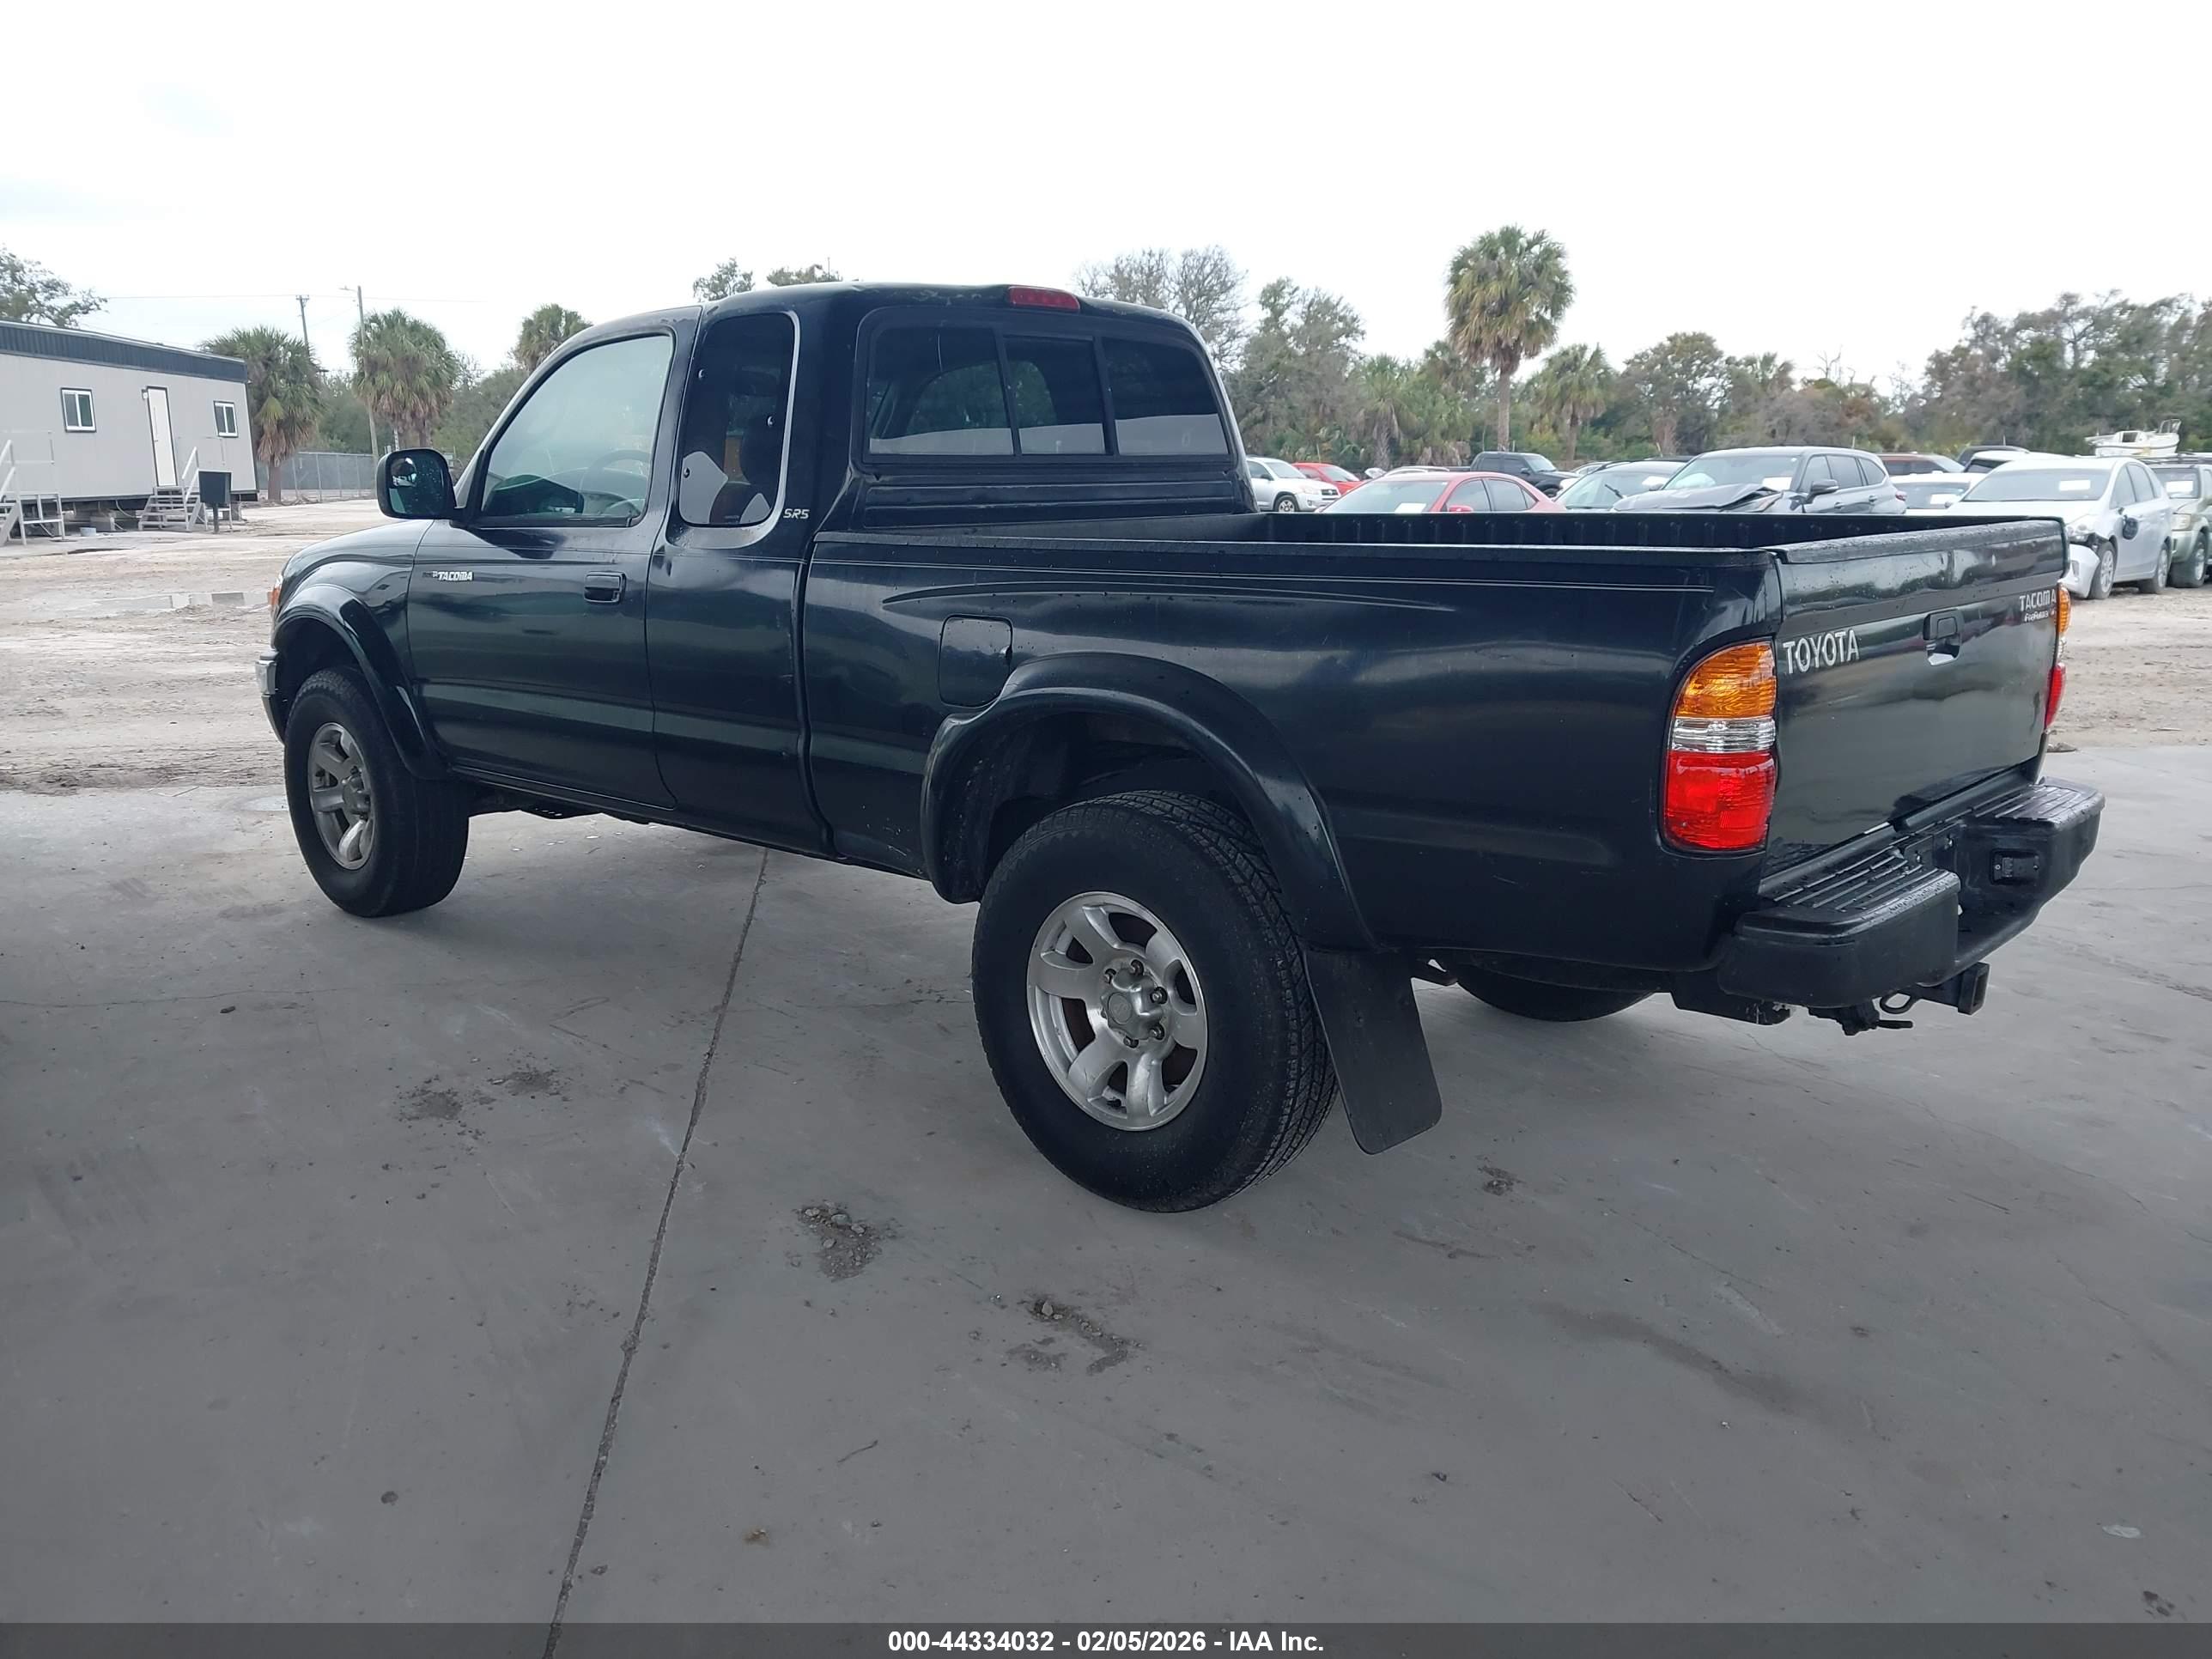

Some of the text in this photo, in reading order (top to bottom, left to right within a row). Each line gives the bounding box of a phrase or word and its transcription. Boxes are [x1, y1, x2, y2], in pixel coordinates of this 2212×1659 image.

[782, 508, 810, 519] SR5
[438, 571, 473, 581] TACOMA
[2019, 588, 2057, 612] TACOMA
[1783, 629, 1860, 674] TOYOTA
